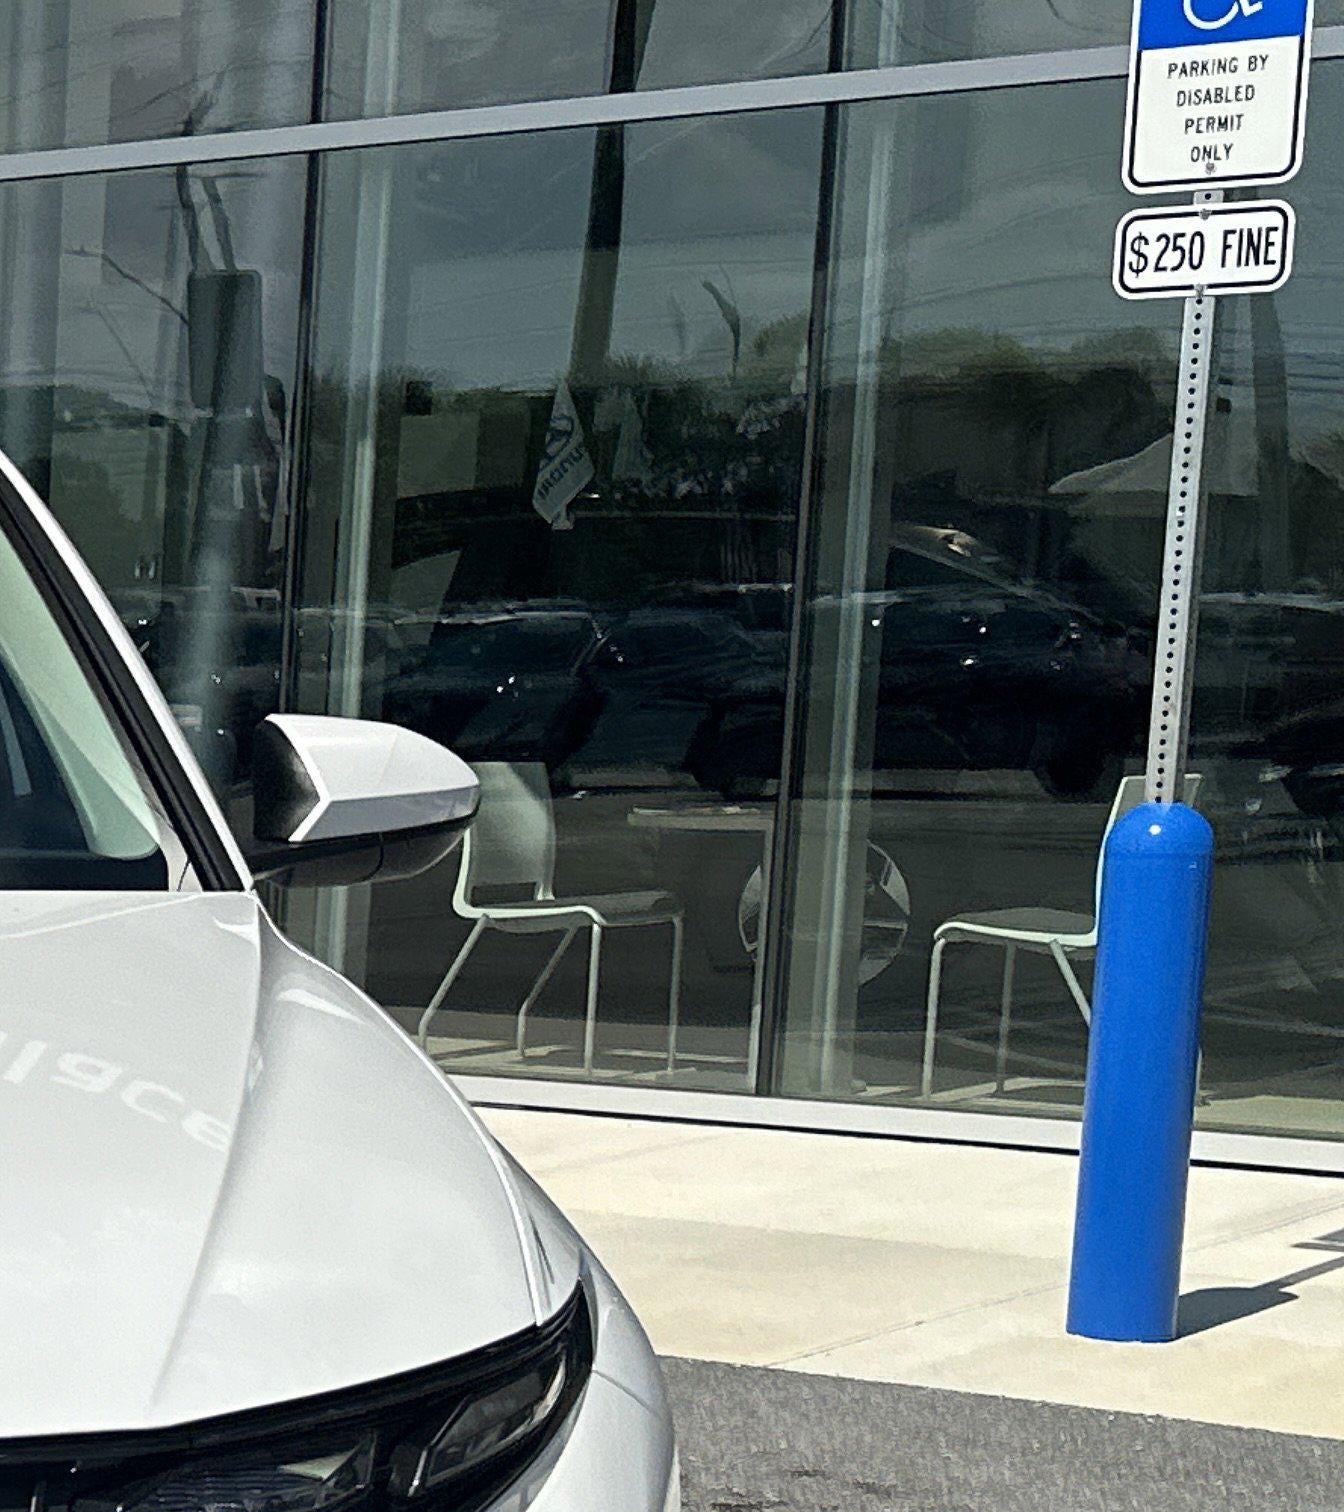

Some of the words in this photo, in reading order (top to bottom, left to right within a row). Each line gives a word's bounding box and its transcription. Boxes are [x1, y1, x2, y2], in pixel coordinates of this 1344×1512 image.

[1167, 57, 1239, 79] PARKING
[1247, 54, 1269, 72] BY
[1176, 84, 1255, 107] DISABLED
[1184, 113, 1244, 135] PERMIT
[1190, 143, 1234, 163] ONLY
[1128, 231, 1206, 278] $250
[1221, 226, 1280, 268] FINE
